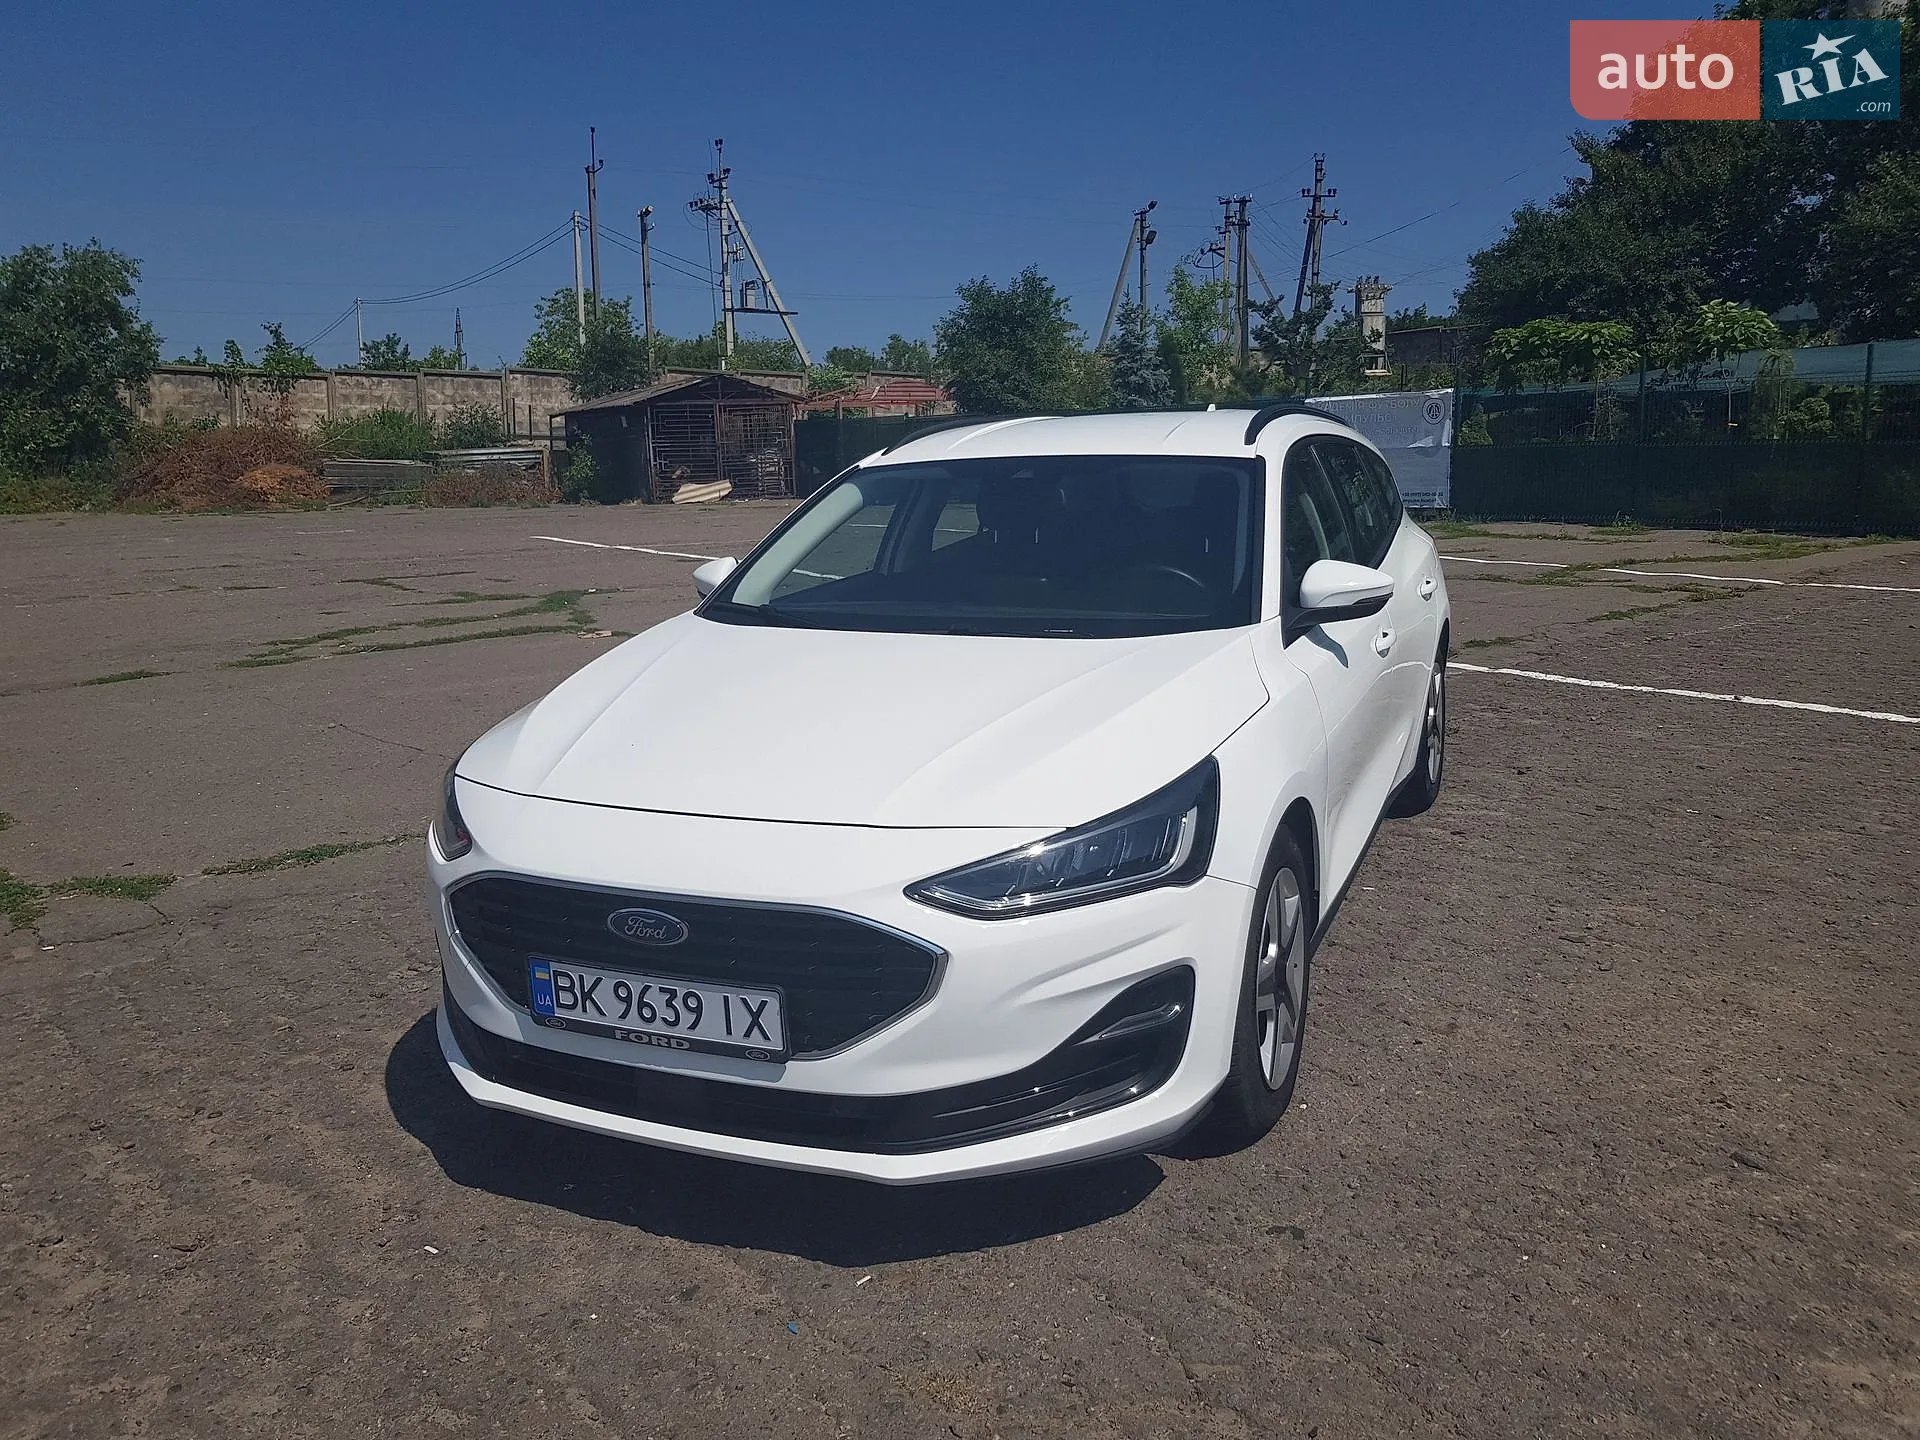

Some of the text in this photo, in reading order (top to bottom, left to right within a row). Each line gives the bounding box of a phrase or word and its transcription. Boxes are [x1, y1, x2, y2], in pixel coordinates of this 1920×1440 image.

[624, 914, 667, 940] Ford
[537, 993, 552, 1007] UA
[552, 969, 772, 1042] BK 9639 IX
[614, 1029, 690, 1050] FORD
